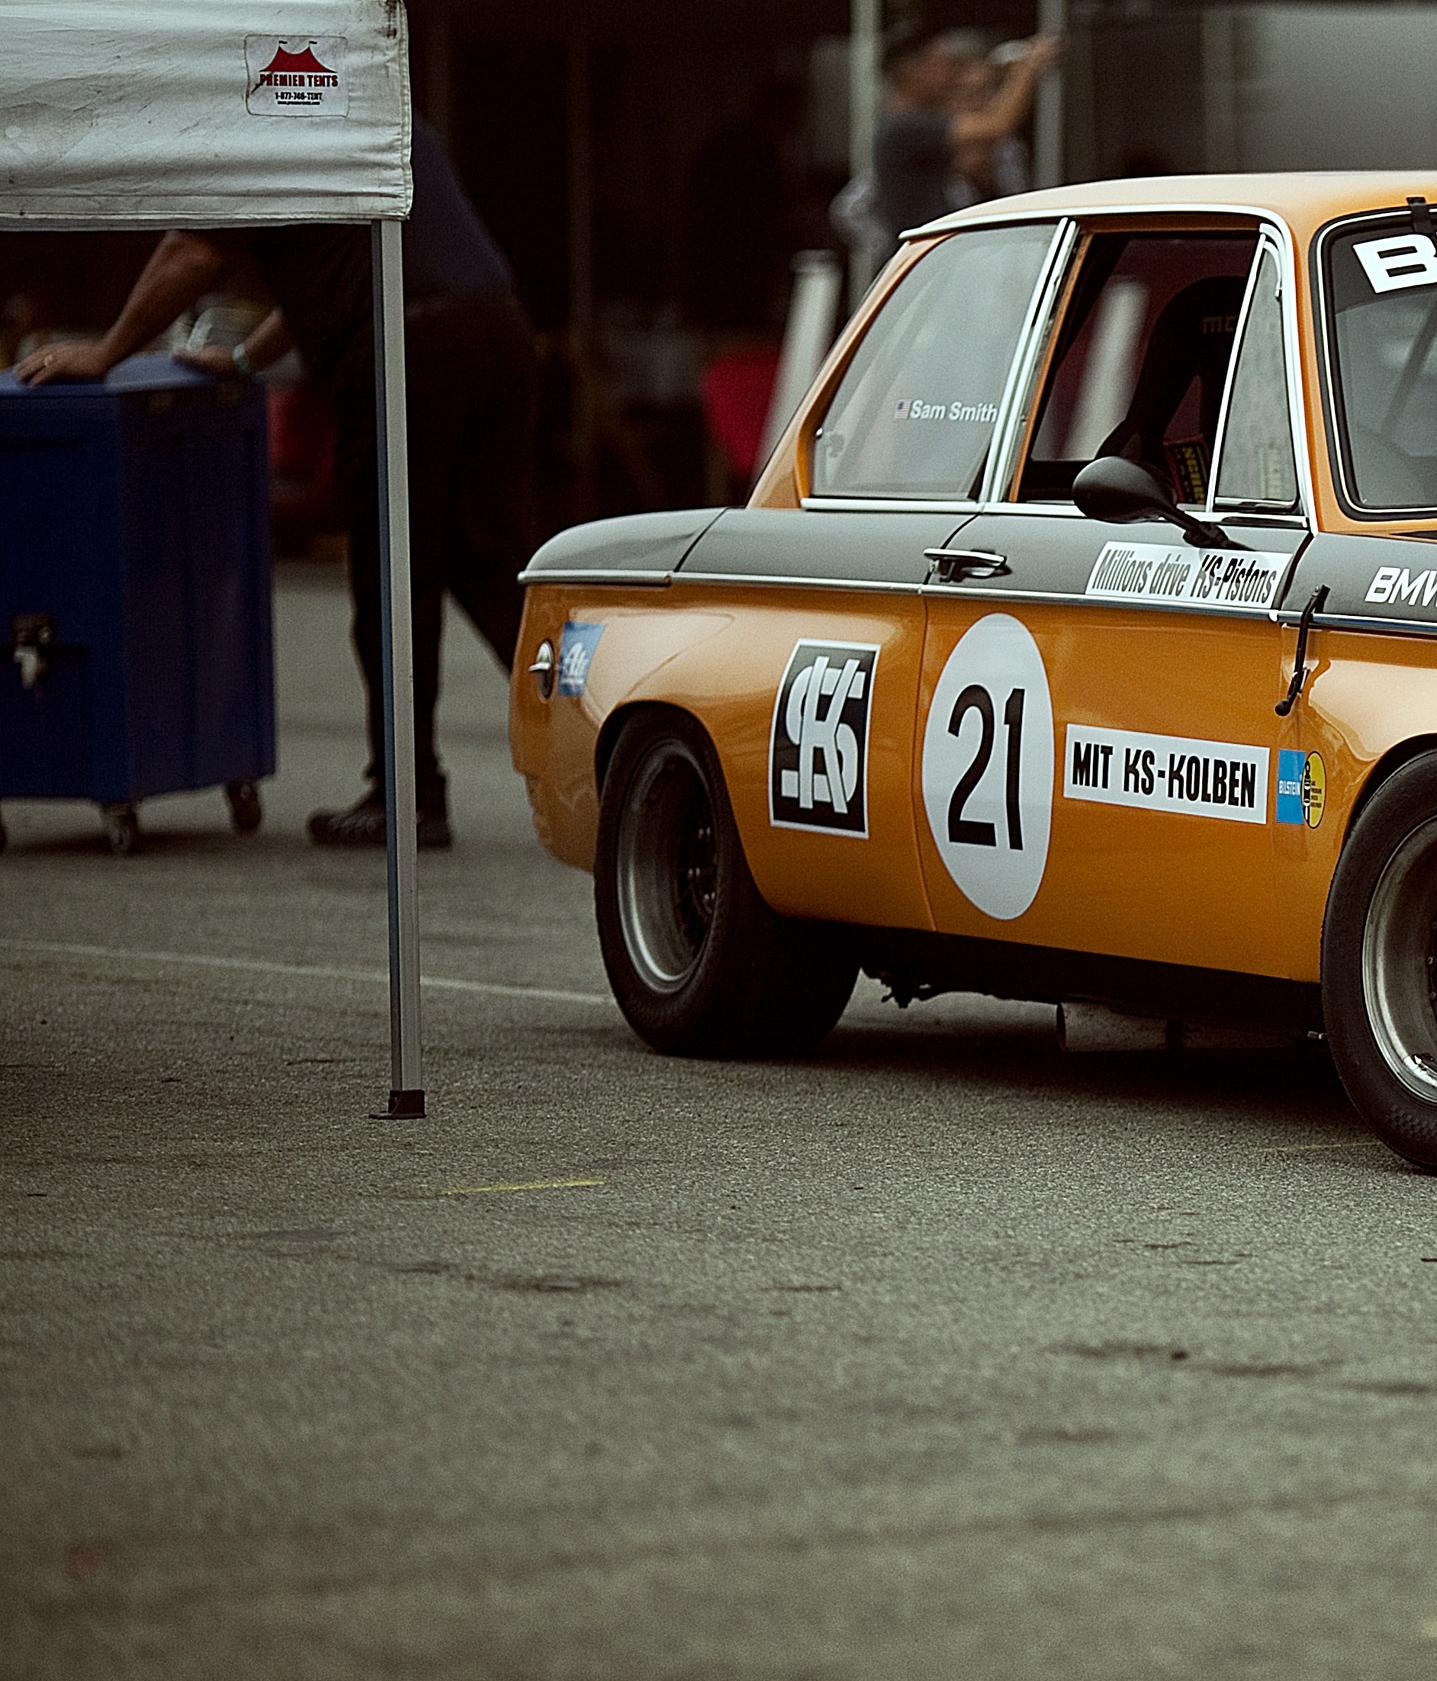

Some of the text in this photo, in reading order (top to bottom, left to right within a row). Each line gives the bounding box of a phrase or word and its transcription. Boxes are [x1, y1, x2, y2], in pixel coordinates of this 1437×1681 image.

[260, 74, 338, 87] PREMIER TENTS
[910, 400, 998, 423] Sam Smith
[1092, 549, 1277, 604] Millions drive KS-Pistons
[948, 683, 1025, 851] 21
[1072, 741, 1113, 789] MIT
[1123, 747, 1256, 808] KS-KOLBEN
